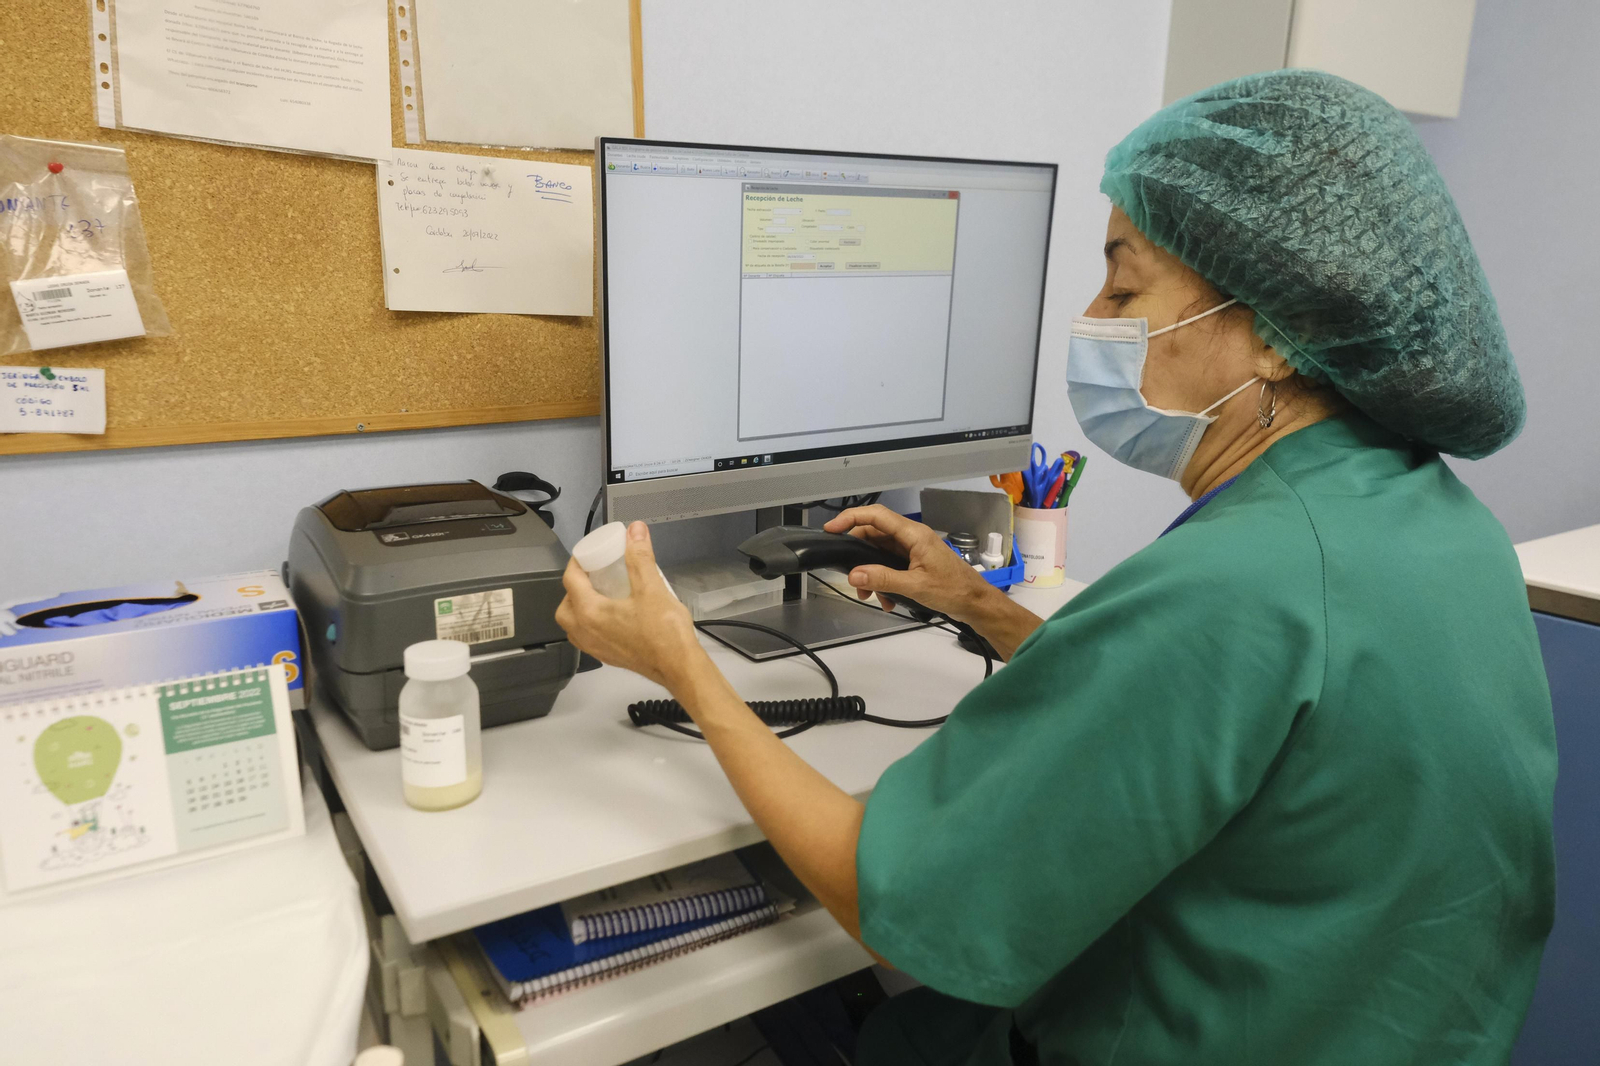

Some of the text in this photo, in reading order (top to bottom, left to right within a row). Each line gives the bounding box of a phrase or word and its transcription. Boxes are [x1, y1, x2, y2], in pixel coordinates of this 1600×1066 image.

[400, 172, 409, 182] Se
[508, 183, 512, 198] y
[527, 174, 572, 191] BANCO
[745, 194, 776, 202] Recepción
[237, 586, 265, 597] S
[272, 650, 300, 682] S
[168, 691, 237, 711] SEPTIEMBRE
